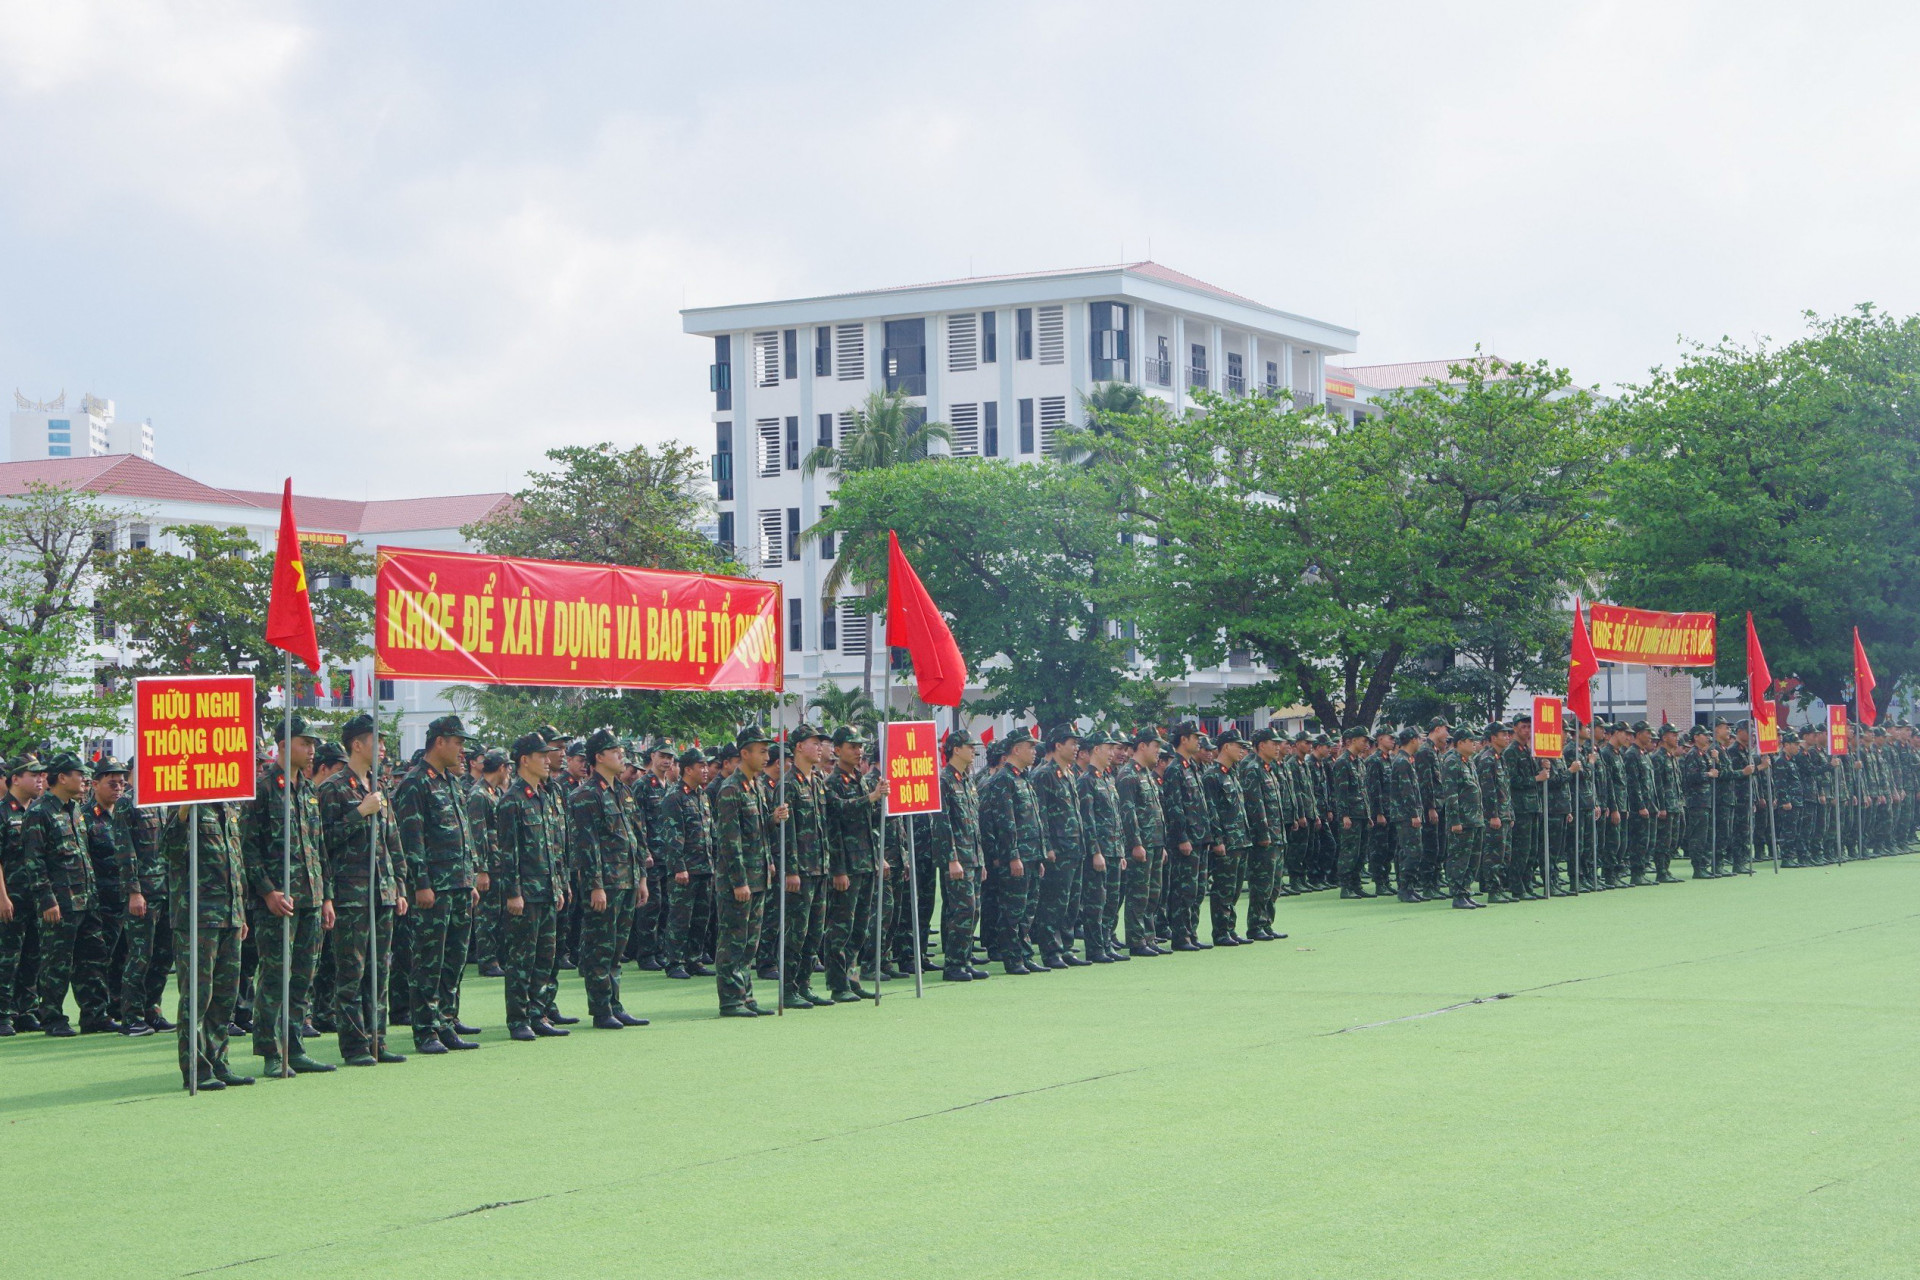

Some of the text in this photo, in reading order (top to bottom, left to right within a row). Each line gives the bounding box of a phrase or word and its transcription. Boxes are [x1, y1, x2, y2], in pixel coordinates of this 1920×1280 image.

[388, 572, 456, 651] KHỎE
[461, 572, 500, 654] ĐỂ
[501, 586, 548, 656] XÂY
[553, 596, 611, 671] DỰNG
[616, 594, 642, 661] VÀ
[646, 589, 683, 662] BẢO
[687, 599, 708, 676] VỆ
[711, 591, 731, 664] TỔ
[152, 688, 240, 723] HỮU NGHỊ
[144, 723, 248, 757] THÔNG QUA
[906, 727, 916, 751] VÌ
[153, 754, 240, 793] THỂ THAO
[891, 750, 935, 779] SỨC KHỎE
[899, 779, 929, 808] BỘ ĐỘI
